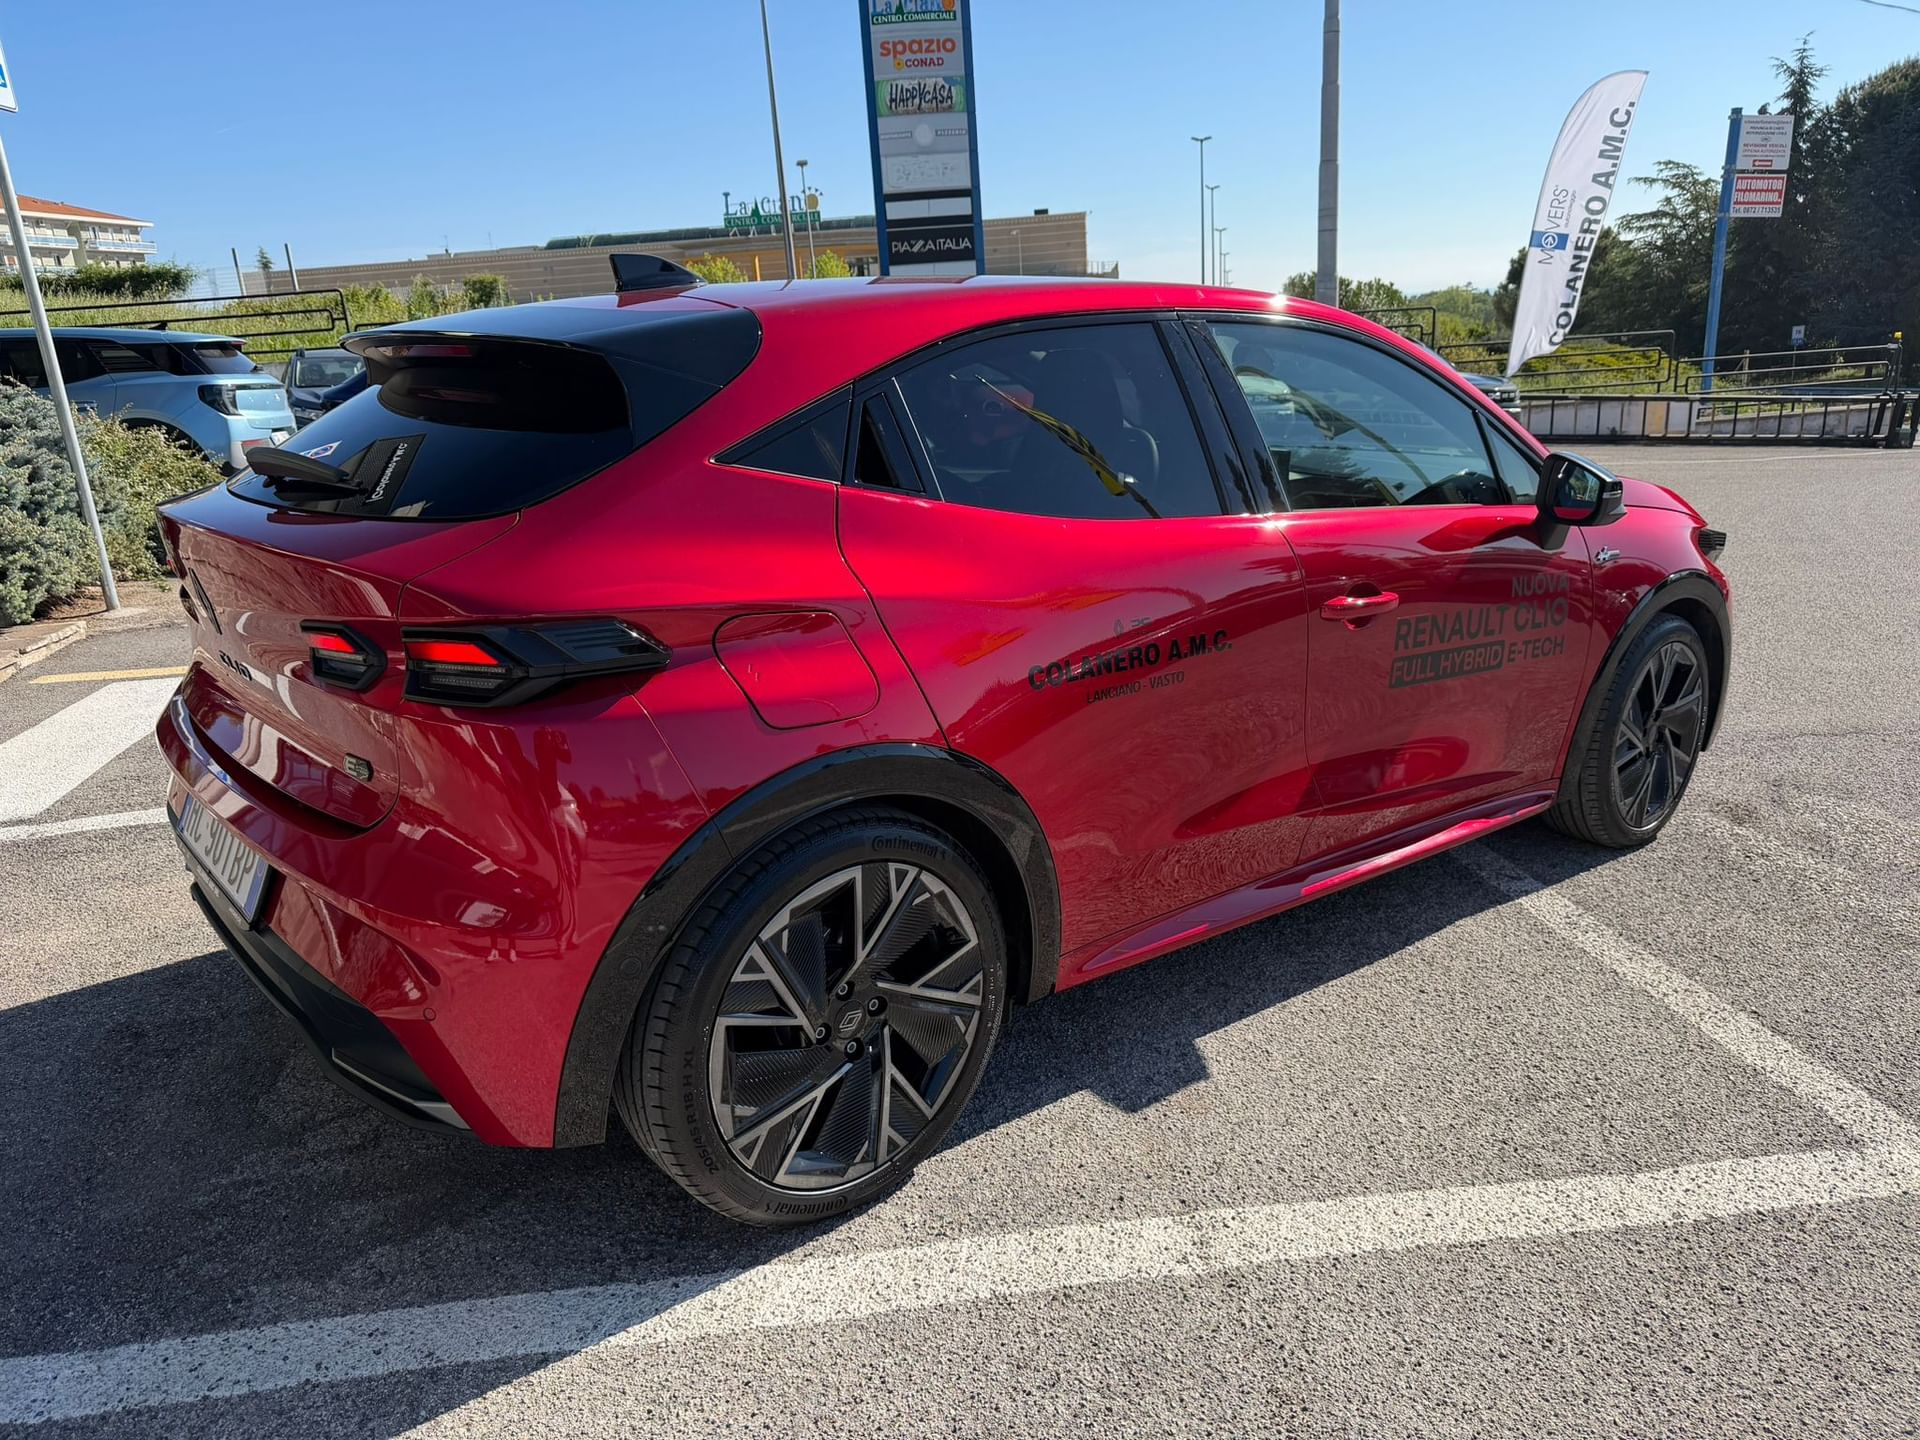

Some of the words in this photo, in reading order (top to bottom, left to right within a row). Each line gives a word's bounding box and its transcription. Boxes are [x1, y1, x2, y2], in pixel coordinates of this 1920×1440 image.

[873, 14, 902, 24] CENTRO
[903, 11, 955, 21] COMMERCIALE
[880, 37, 957, 58] spazio
[905, 57, 944, 68] CONAD
[1736, 179, 1783, 190] AUTOMOTOR
[725, 216, 757, 227] CENTRO
[1549, 196, 1608, 346] COLANERO
[1591, 101, 1635, 192] A.M.C.
[1512, 573, 1568, 597] NUOVA
[1395, 605, 1510, 651] RENAULT
[1514, 597, 1568, 632] CLIO
[1028, 643, 1161, 691] COLANERO
[1168, 629, 1232, 662] A.M.C.
[1391, 656, 1435, 685] FULL
[1439, 645, 1502, 675] HYBRID
[1507, 635, 1565, 663] E-TECH
[1087, 680, 1141, 704] LANCIANO
[1149, 671, 1185, 688] VASTO
[871, 834, 939, 857] Continental
[773, 1195, 848, 1216] Continental
